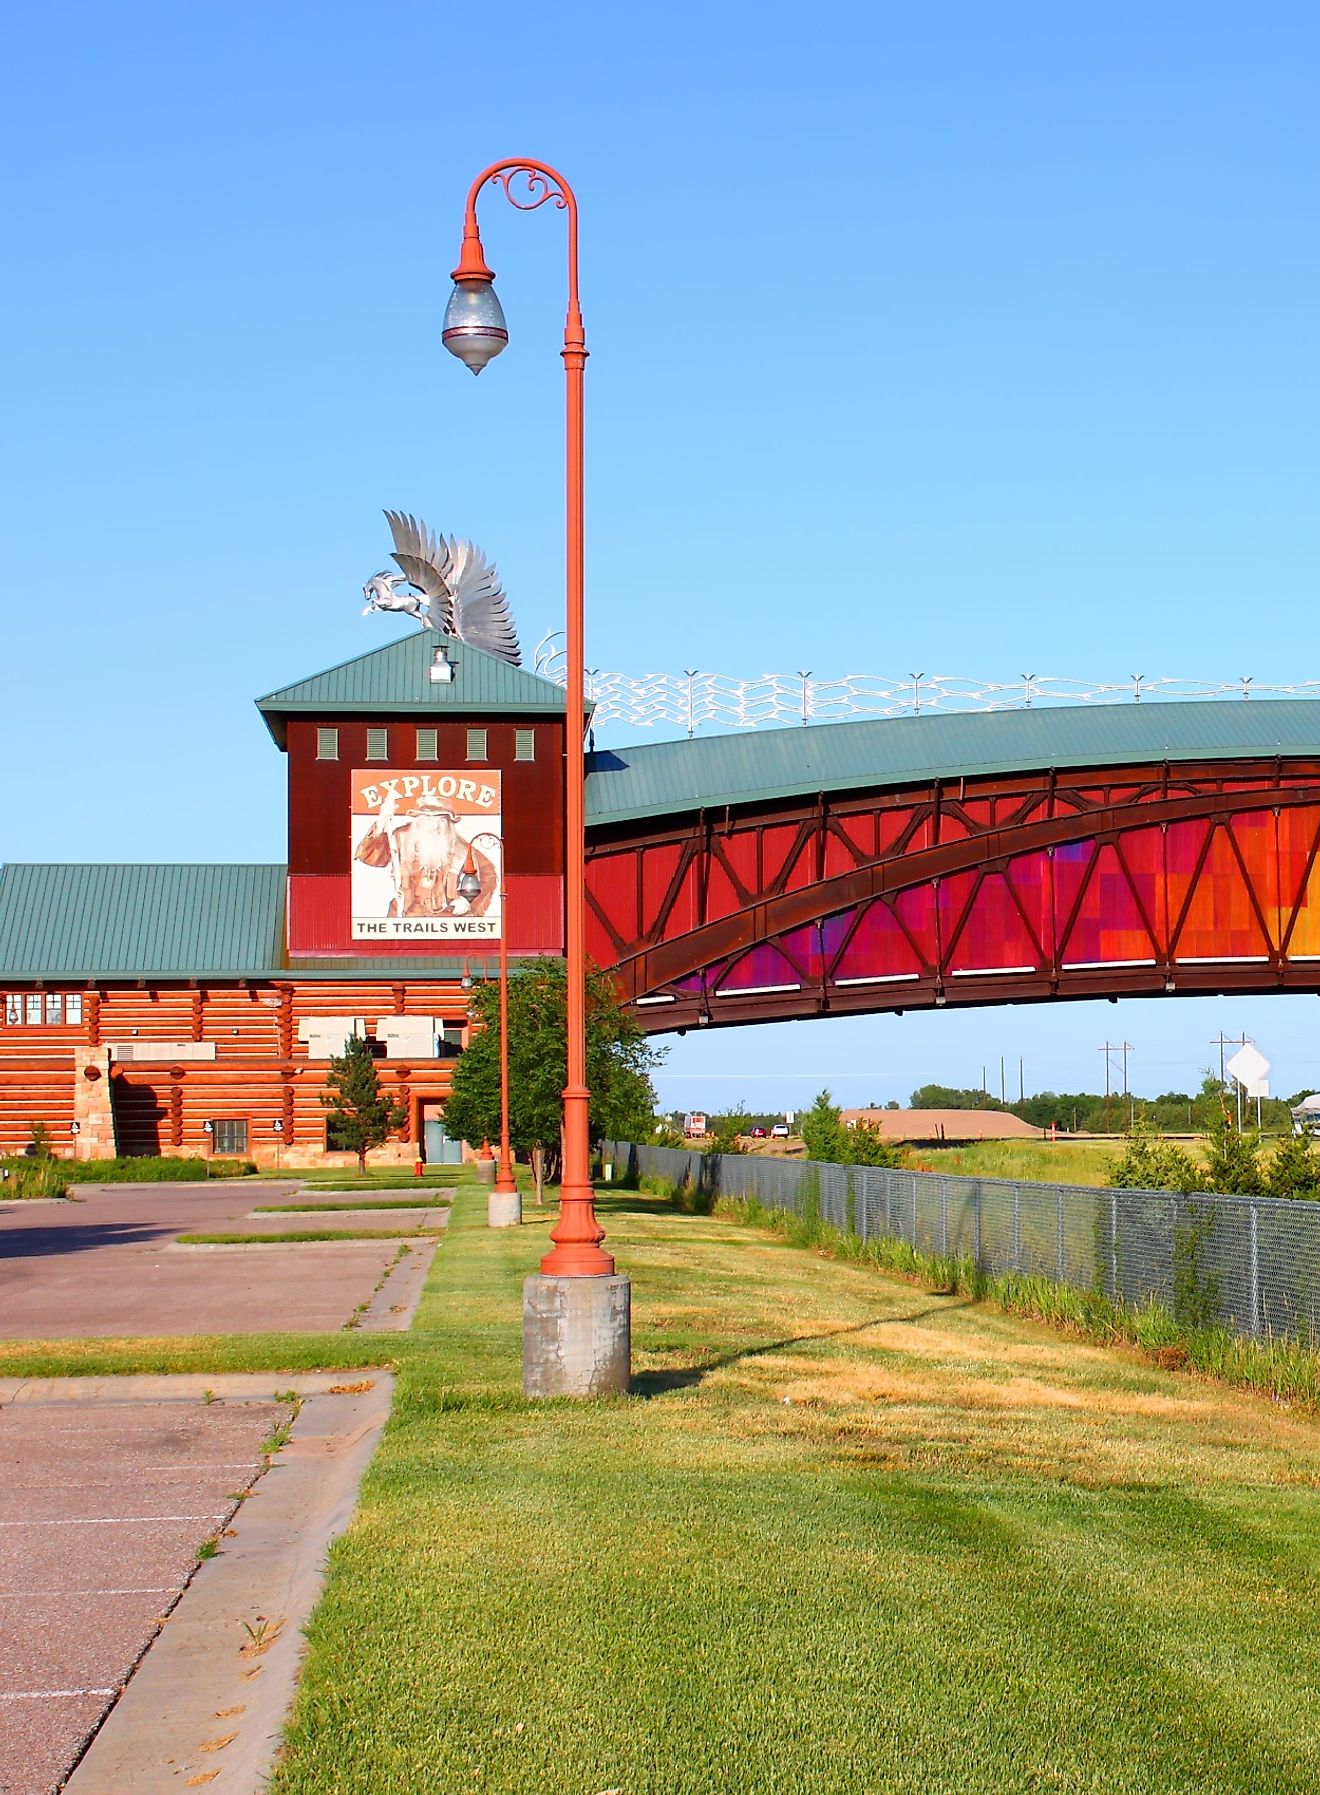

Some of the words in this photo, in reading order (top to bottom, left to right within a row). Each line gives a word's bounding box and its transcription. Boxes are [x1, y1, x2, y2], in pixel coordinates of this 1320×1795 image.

[360, 775, 496, 809] EXPLORE
[357, 922, 387, 933] THE
[392, 922, 449, 933] TRAILS
[453, 922, 497, 933] WEST
